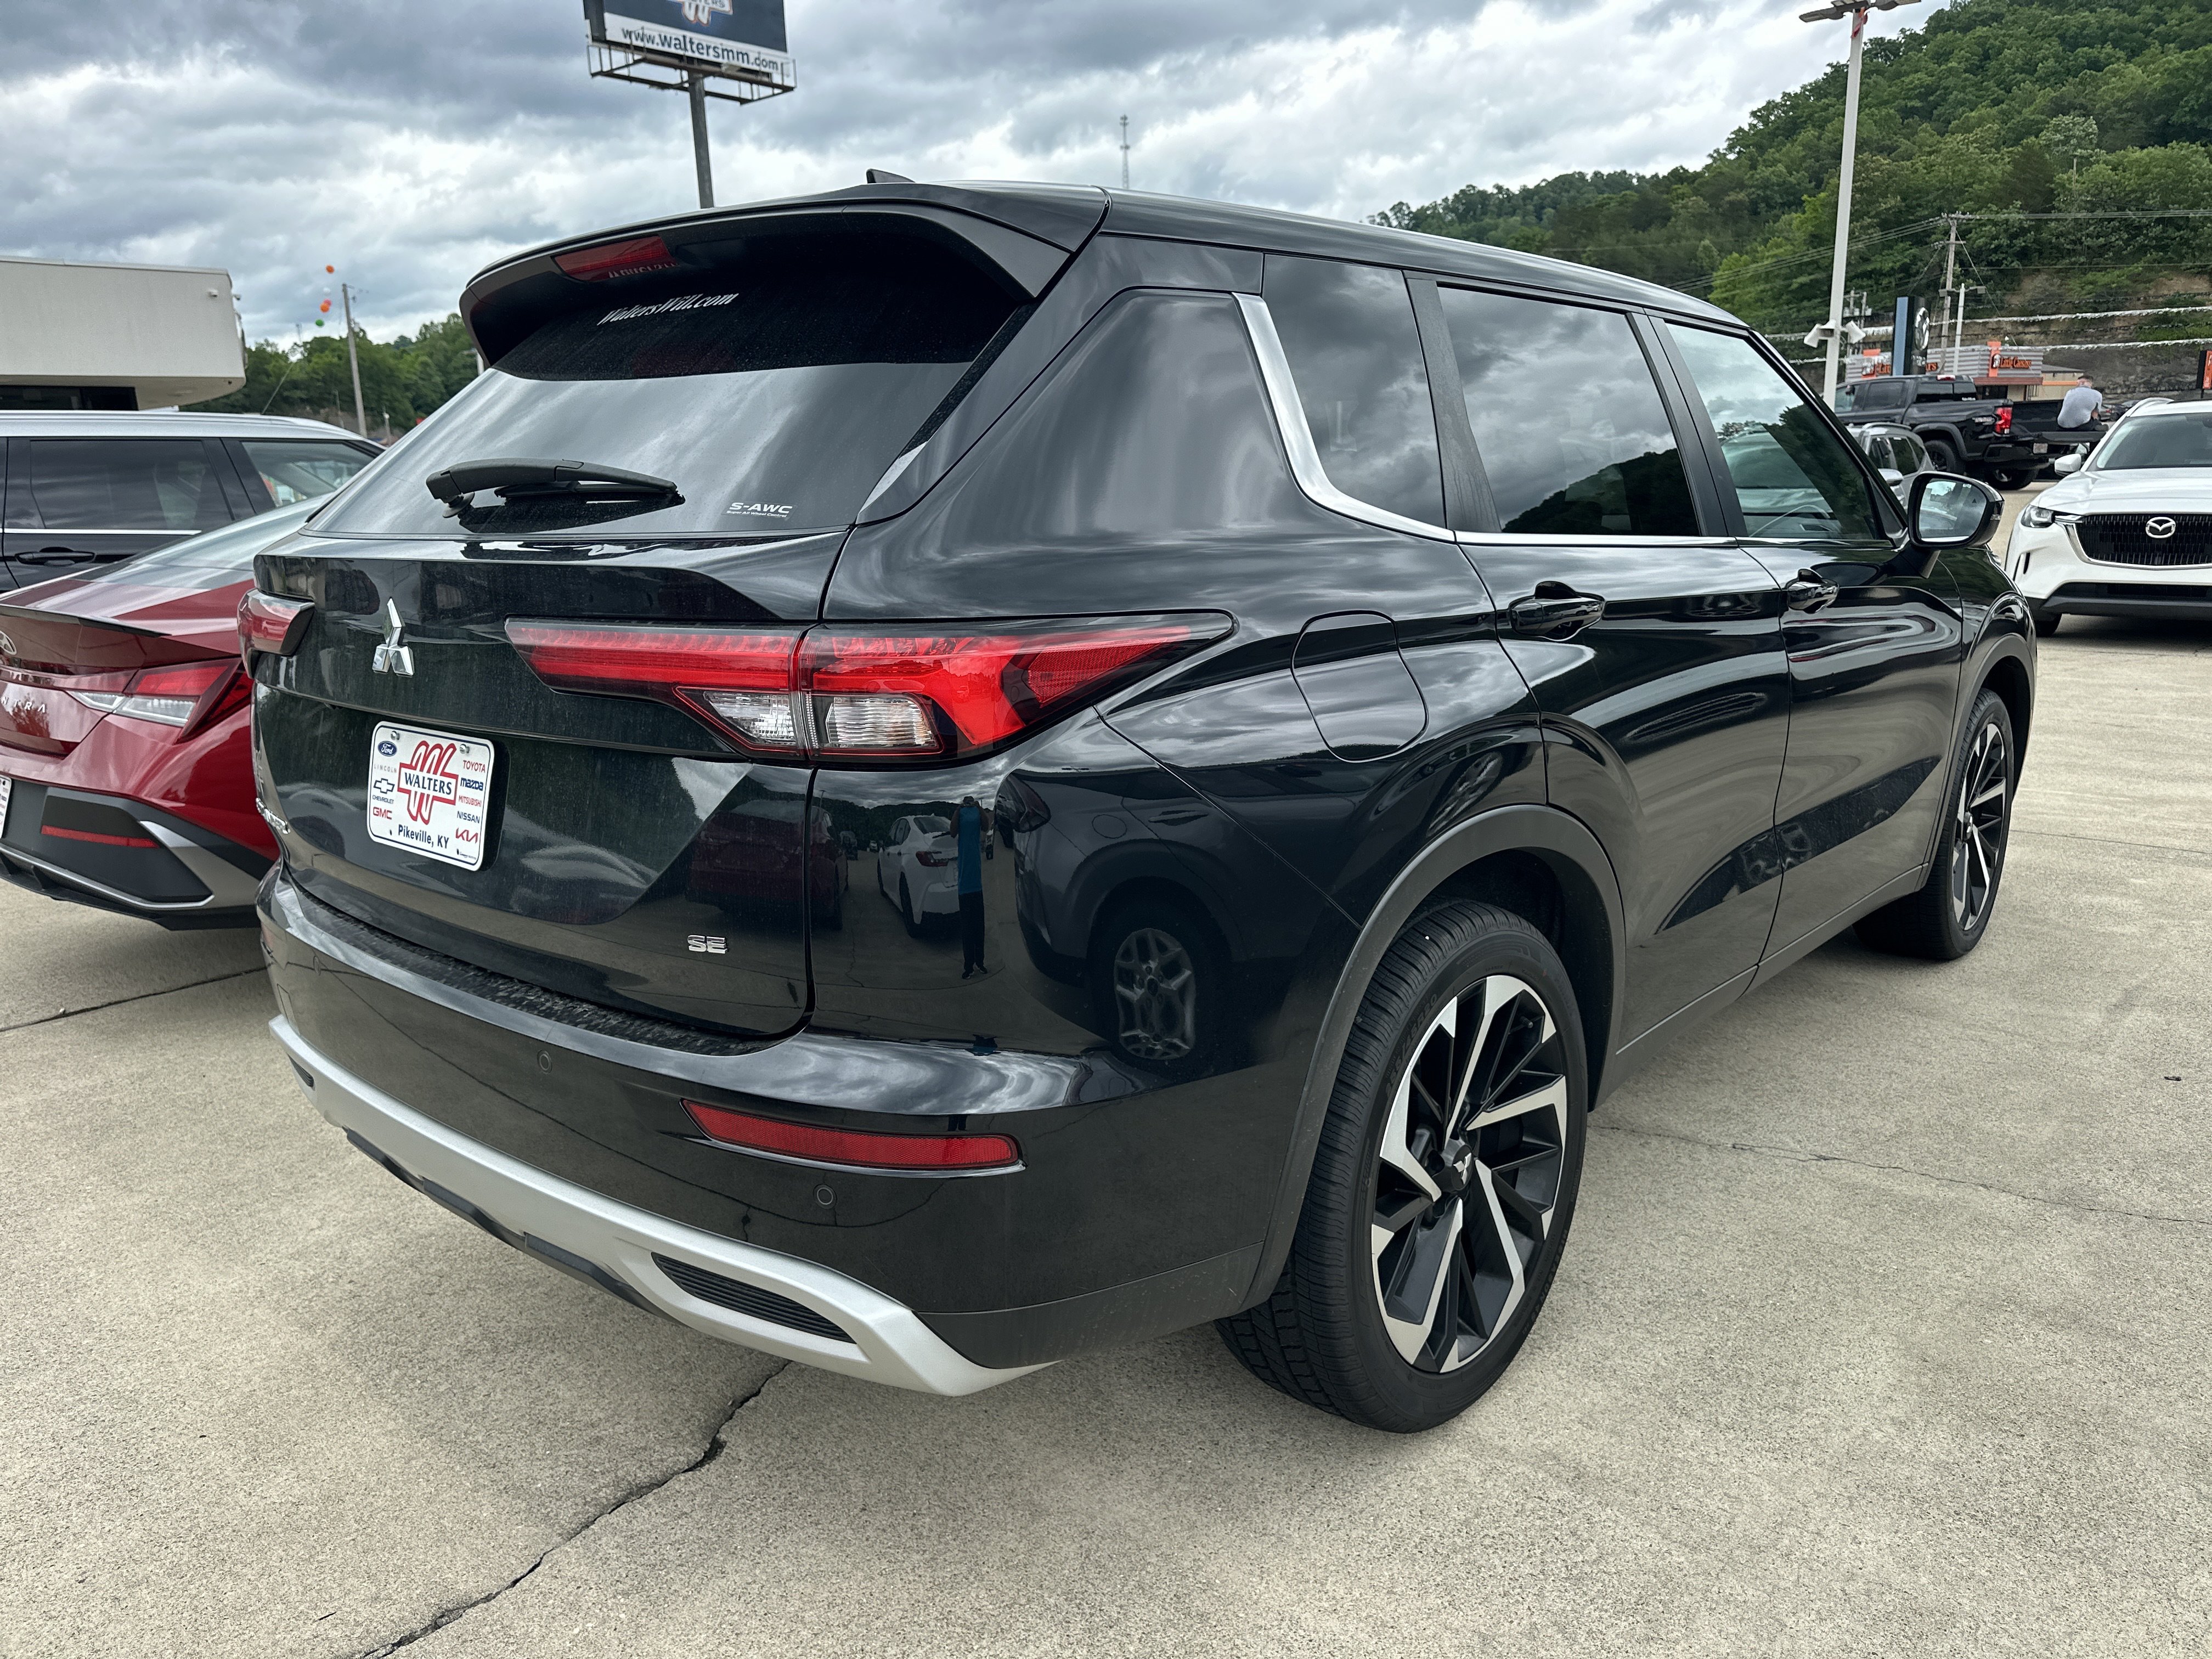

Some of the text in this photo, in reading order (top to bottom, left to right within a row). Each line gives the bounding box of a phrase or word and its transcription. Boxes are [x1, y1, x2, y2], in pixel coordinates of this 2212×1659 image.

[597, 293, 739, 326] WaltersWill.com
[729, 502, 793, 514] S-AWC
[1, 696, 46, 713] NTRA
[374, 764, 397, 774] LINCOLN
[462, 760, 486, 773] TOYOTA
[404, 772, 452, 795] WALTERS
[372, 794, 394, 804] CHEVROLET
[458, 795, 482, 807] MITSUBISHI
[373, 806, 392, 820] GMC
[456, 810, 480, 823] NISSAN
[398, 824, 449, 849] Pikeville, KY
[687, 934, 727, 953] SE
